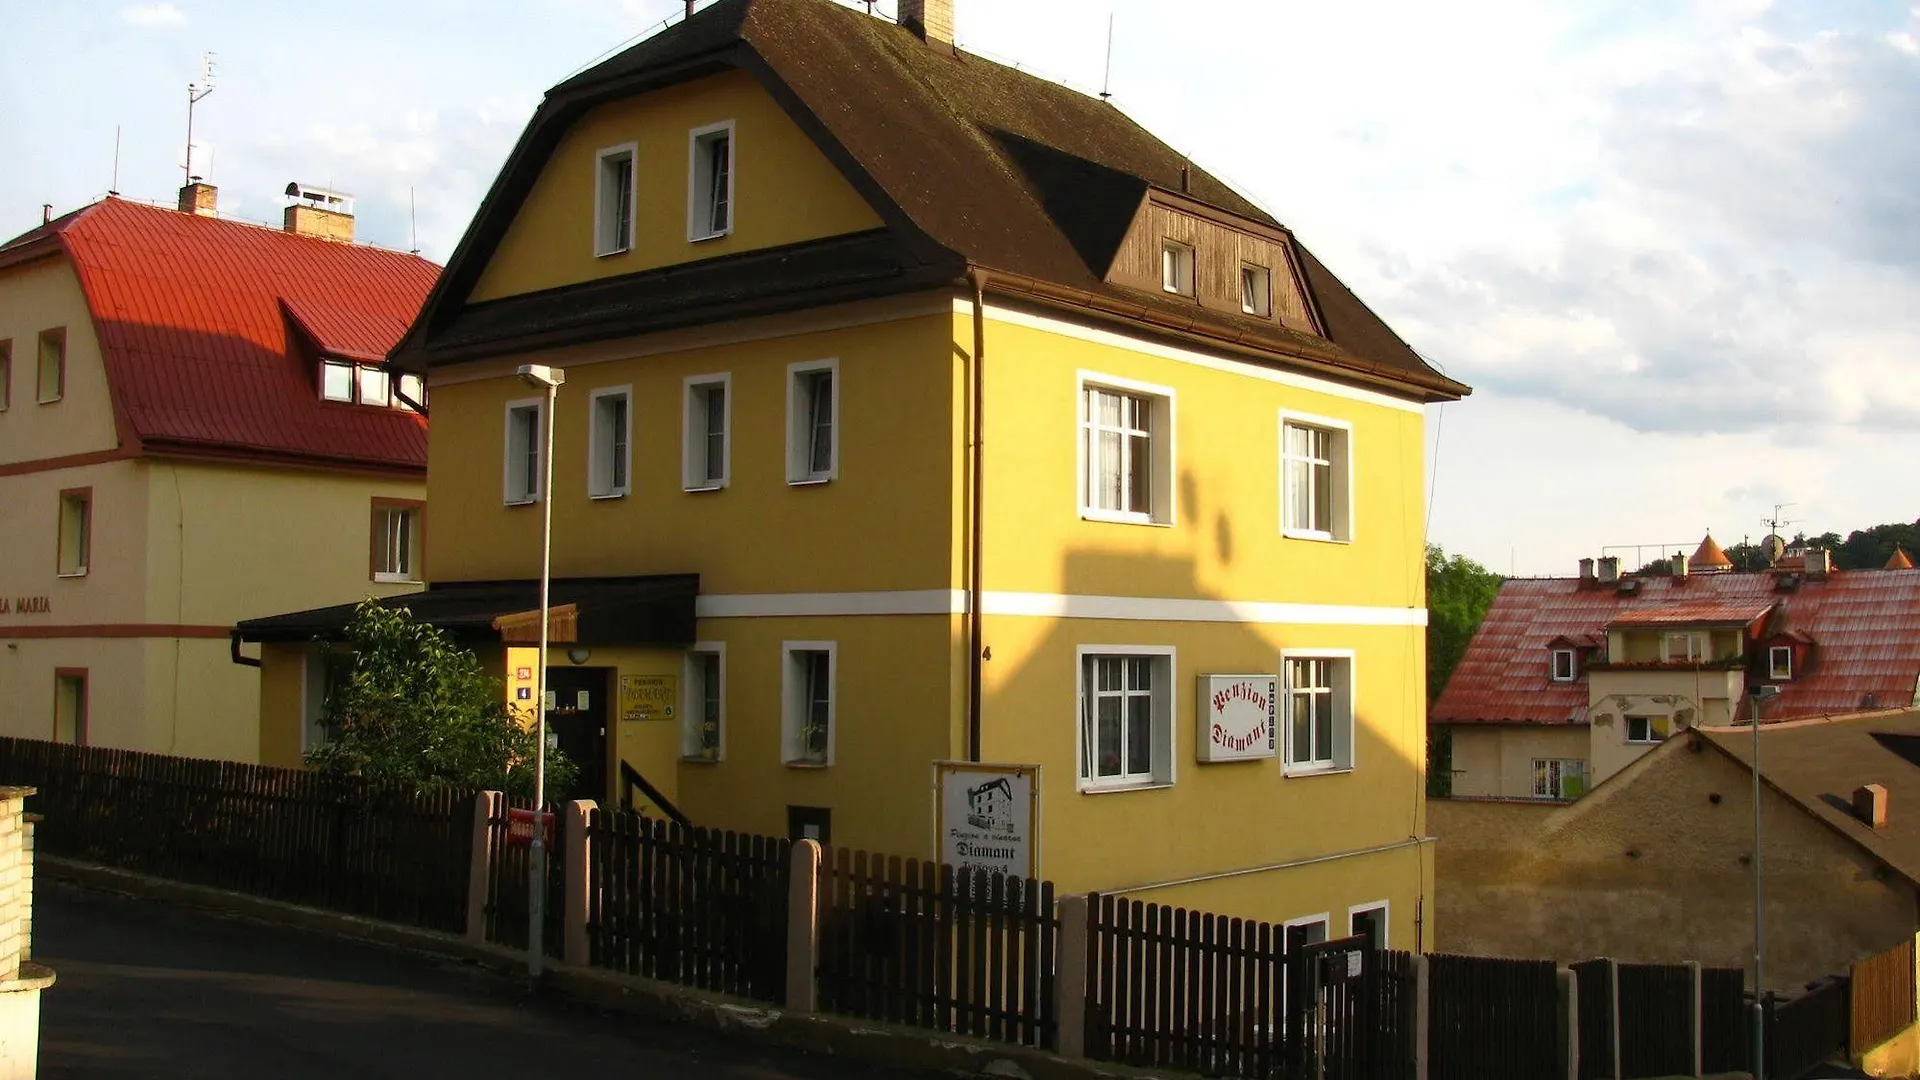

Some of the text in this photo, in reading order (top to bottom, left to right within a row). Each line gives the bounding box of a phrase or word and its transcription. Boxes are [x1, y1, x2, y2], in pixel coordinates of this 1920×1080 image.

[16, 596, 51, 614] MARIA
[521, 688, 527, 699] 4
[1213, 681, 1267, 714] Penzion
[1212, 718, 1267, 752] Diamant
[956, 841, 1015, 859] Diamant
